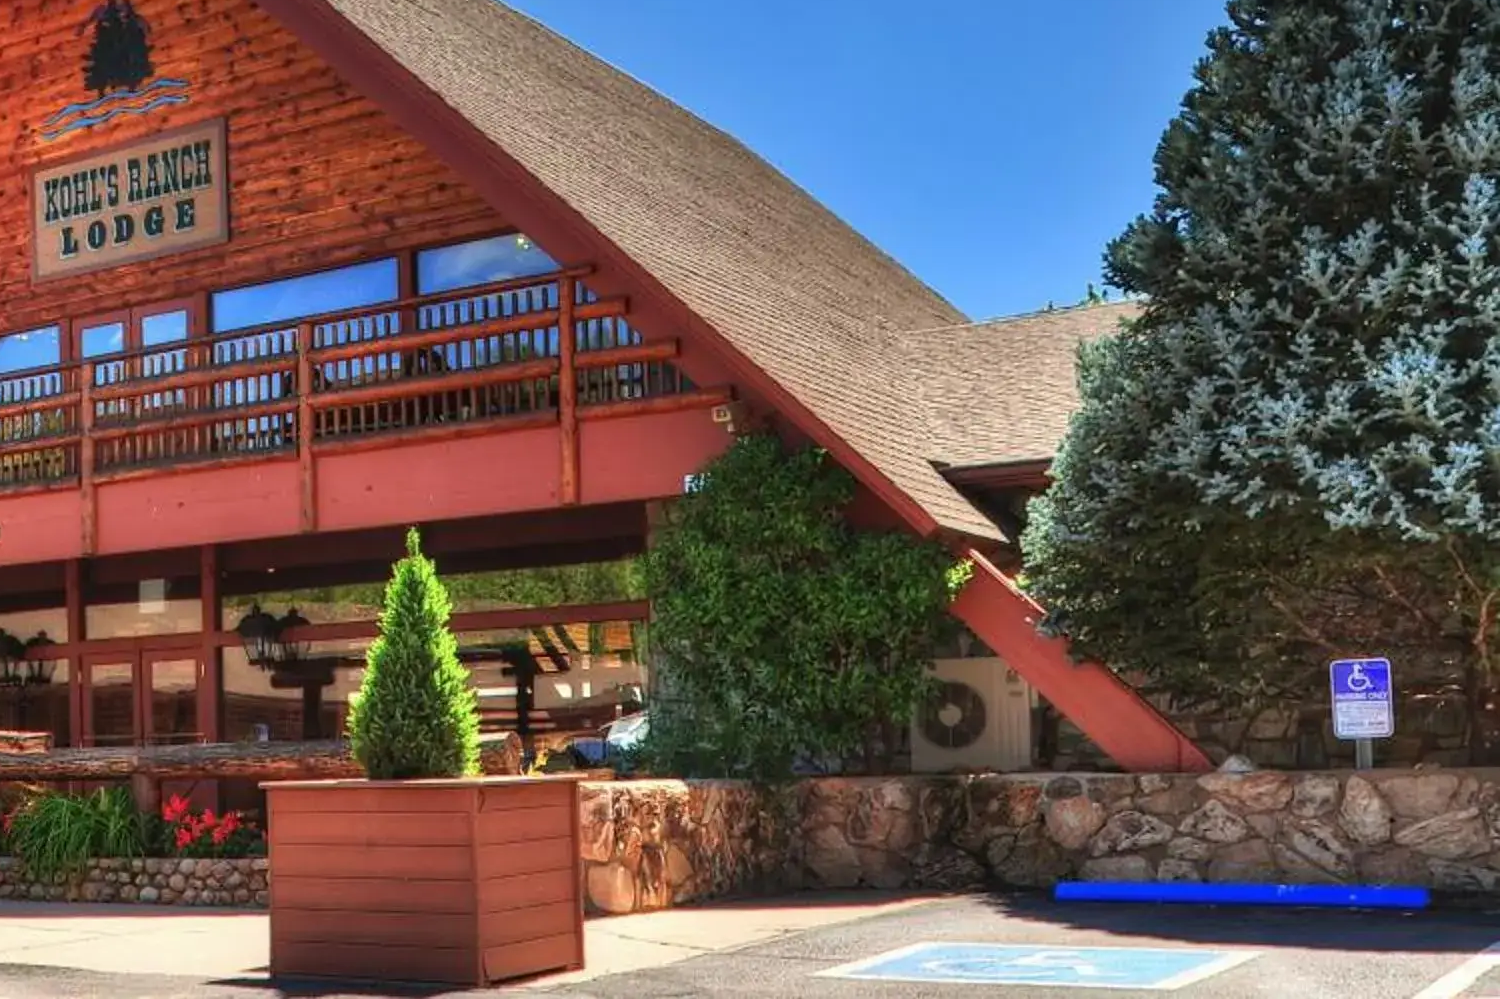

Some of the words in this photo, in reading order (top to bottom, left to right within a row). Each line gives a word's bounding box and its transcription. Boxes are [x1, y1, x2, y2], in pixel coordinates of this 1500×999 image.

[44, 164, 119, 222] KOHL'S
[127, 140, 212, 204] RANCH
[60, 198, 196, 258] LODGE
